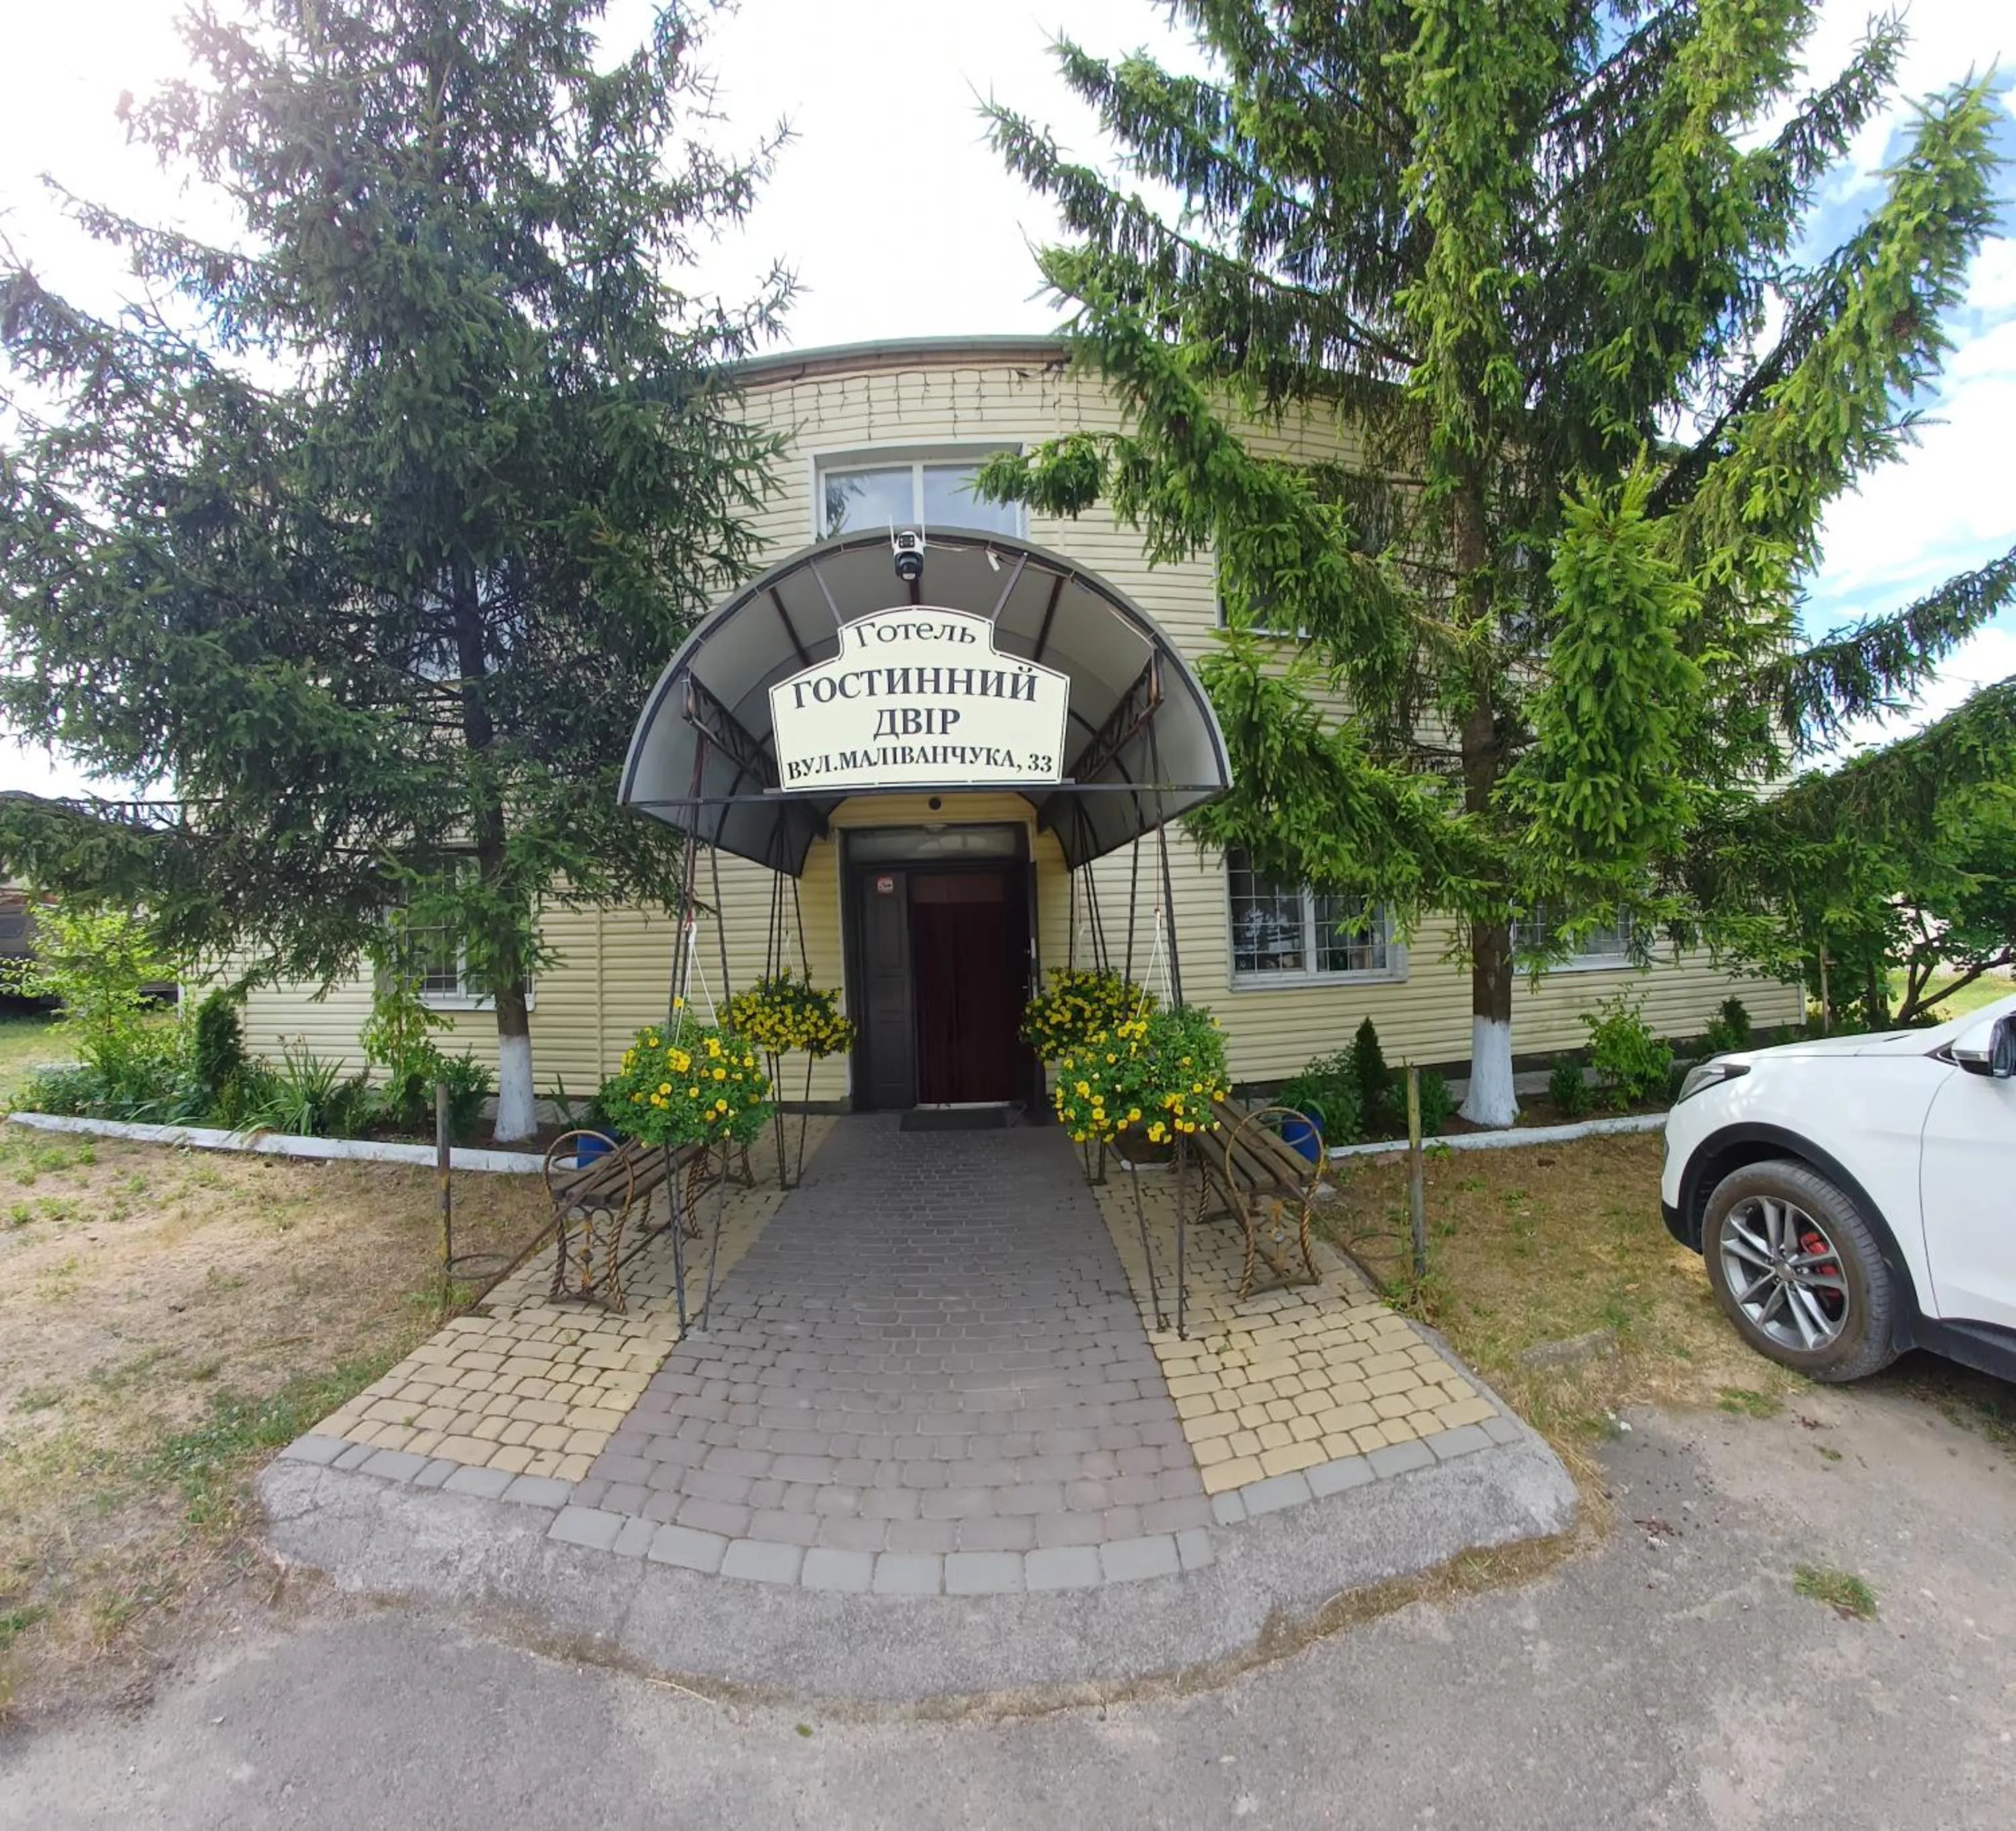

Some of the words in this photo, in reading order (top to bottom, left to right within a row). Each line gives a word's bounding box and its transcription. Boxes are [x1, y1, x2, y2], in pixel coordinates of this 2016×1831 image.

[856, 621, 976, 648] Готель
[792, 666, 1039, 709] ГОСТИННИЙ
[874, 708, 961, 740] ДВІР
[1027, 753, 1053, 774] 33
